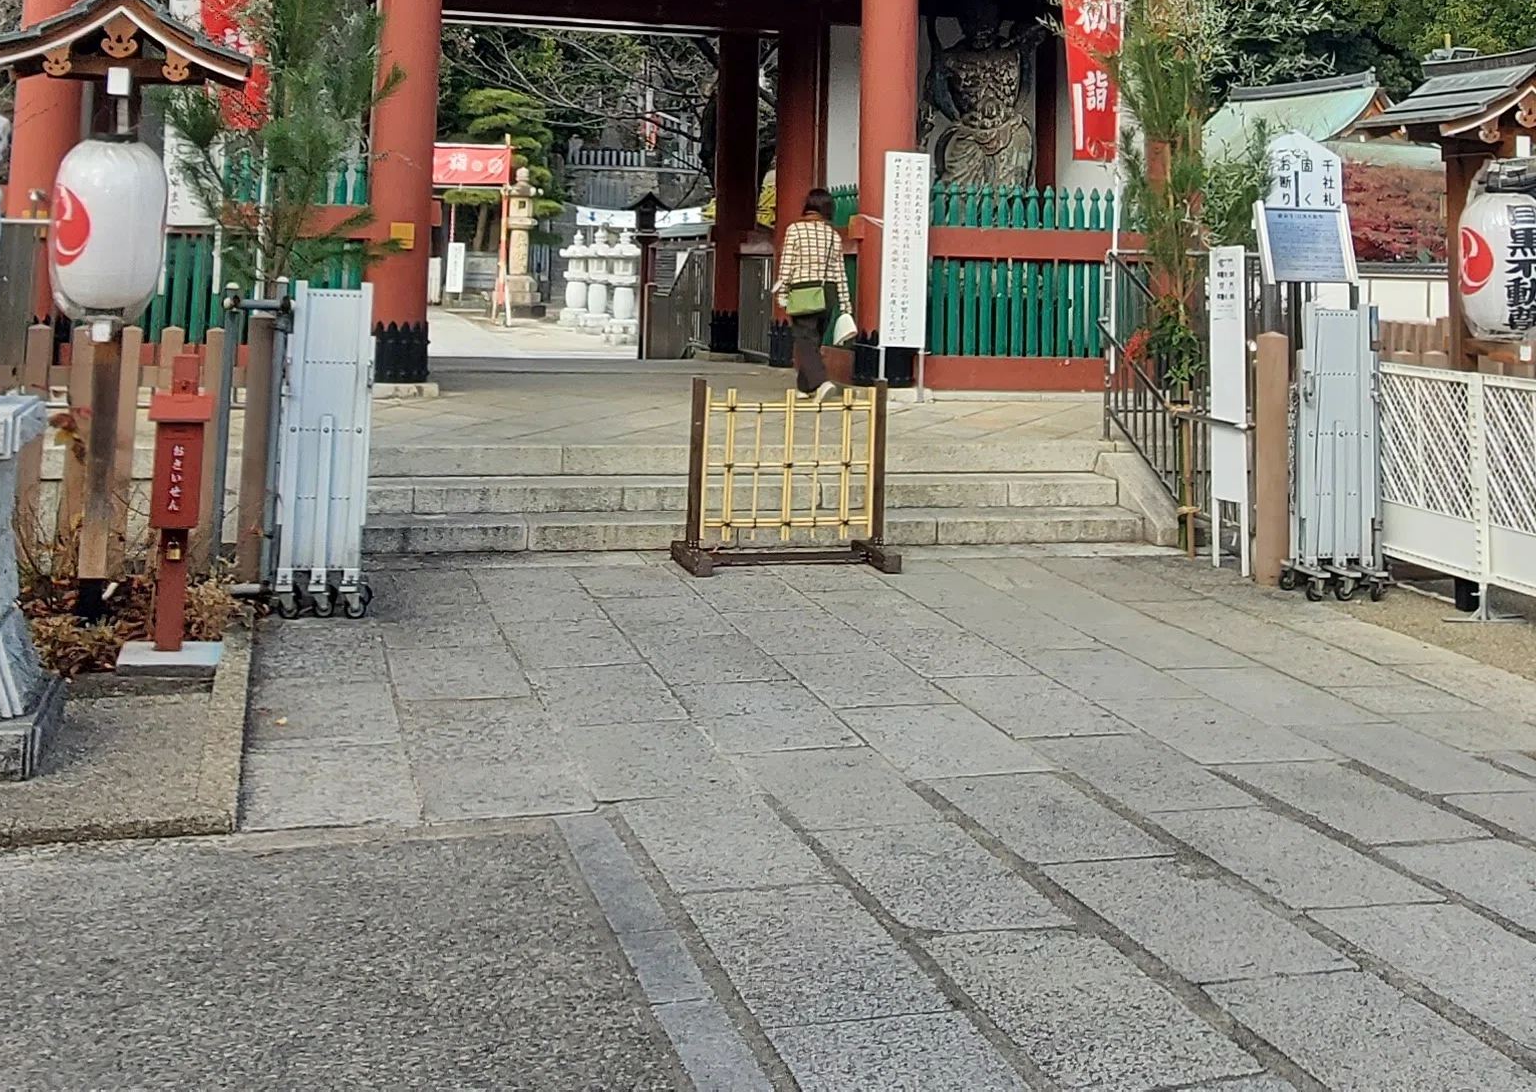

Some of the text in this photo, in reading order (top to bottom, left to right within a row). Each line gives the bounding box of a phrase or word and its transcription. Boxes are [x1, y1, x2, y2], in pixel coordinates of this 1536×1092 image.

[1277, 158, 1292, 206] お断り
[1301, 158, 1314, 207] 固く
[1322, 158, 1337, 207] 千社札
[166, 444, 185, 512] おさいせん
